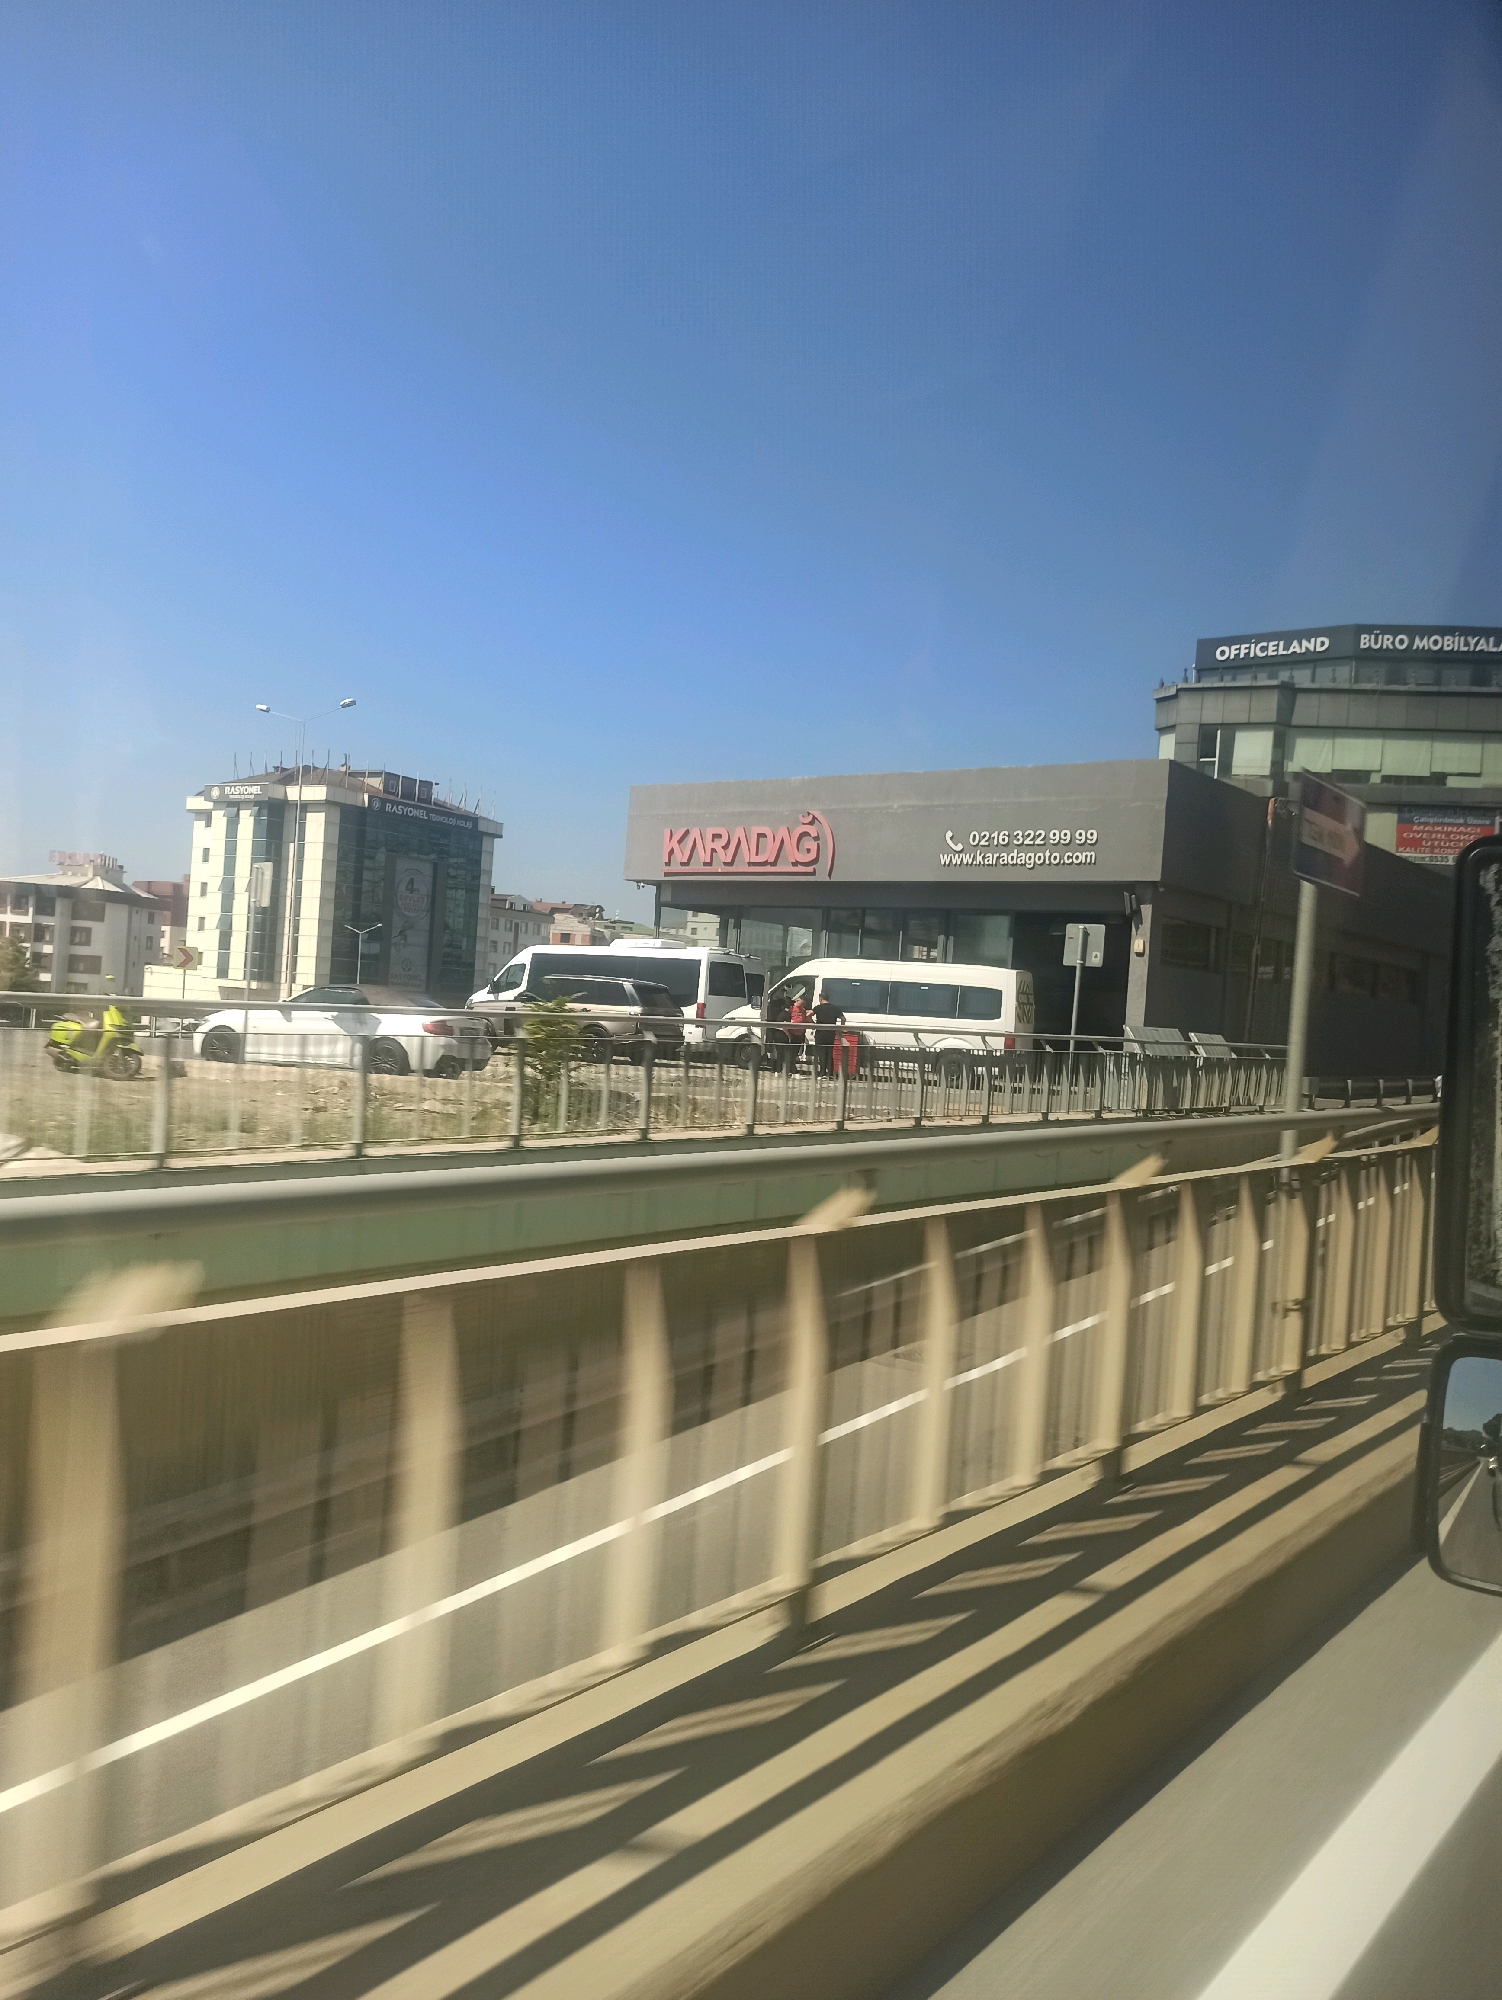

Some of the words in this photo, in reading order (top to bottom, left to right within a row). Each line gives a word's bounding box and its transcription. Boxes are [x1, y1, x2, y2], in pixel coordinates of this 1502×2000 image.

[1359, 630, 1410, 650] BÜRO
[1412, 632, 1502, 652] MOBİLYAL
[224, 785, 262, 795] RASYONEL
[385, 802, 428, 820] RASYONEL
[662, 811, 822, 868] KARADAĞ
[968, 830, 1009, 847] 0216
[1013, 829, 1046, 846] 322
[1049, 829, 1071, 845] 99
[1075, 829, 1098, 845] 99
[939, 849, 1096, 869] www.karadagoto.com
